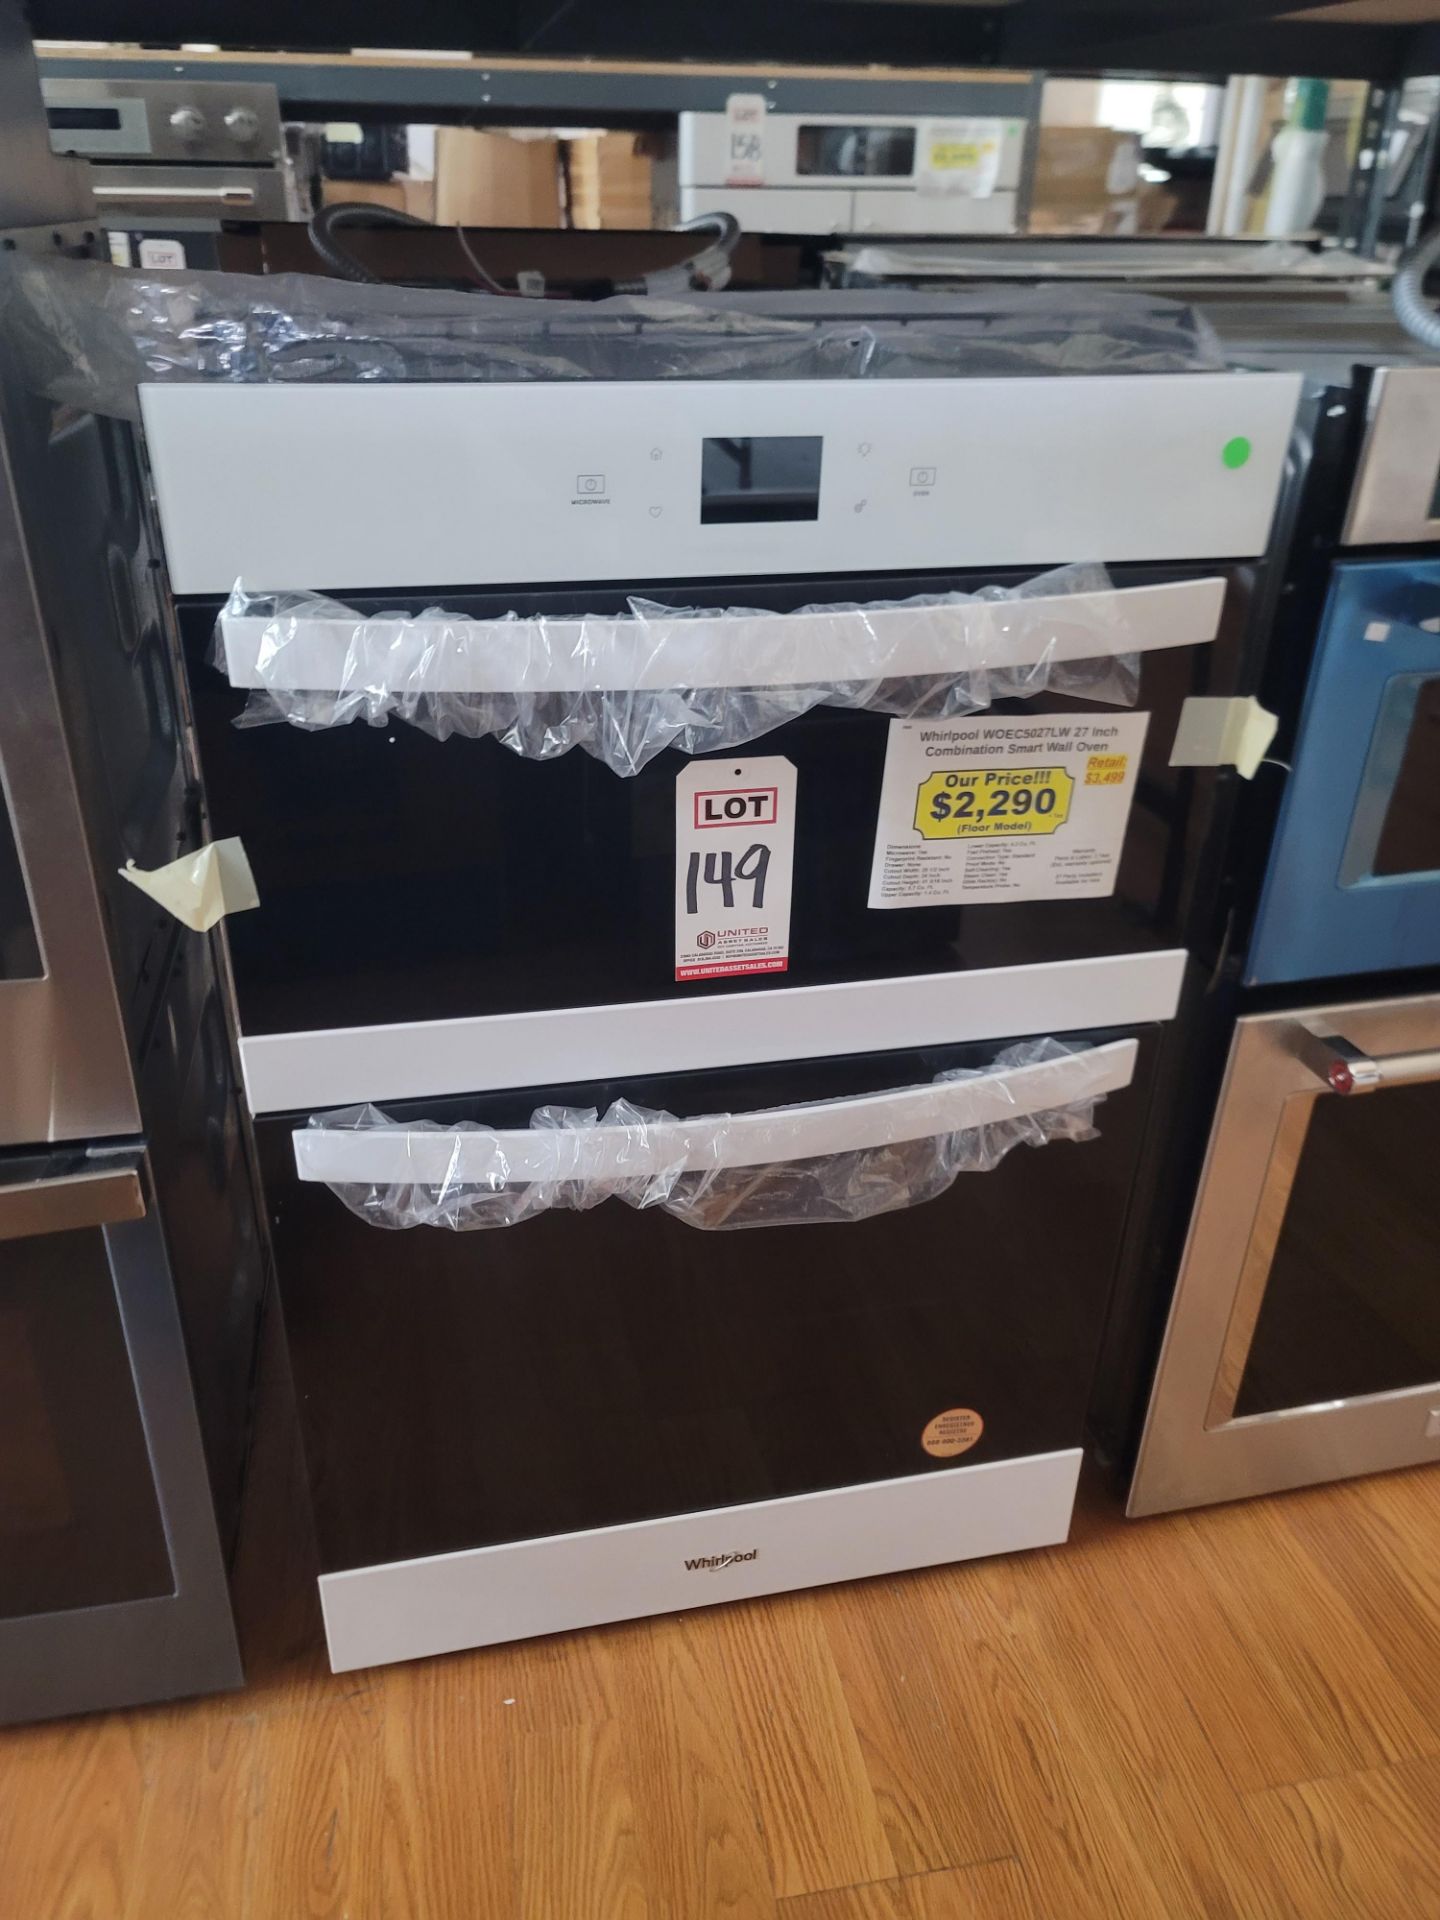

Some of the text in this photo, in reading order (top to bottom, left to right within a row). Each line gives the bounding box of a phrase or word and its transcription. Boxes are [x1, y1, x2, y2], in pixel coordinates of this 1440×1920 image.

[920, 726, 1118, 743] Whirlpool WOEC5027LW 27 Inch
[925, 742, 1108, 757] Combination Smart Wall Oven
[945, 771, 1051, 788] Our Price!!!
[705, 795, 768, 821] LOT
[930, 788, 1056, 822] $2,290
[957, 822, 1032, 835] (Floor Model)
[686, 843, 771, 914] 149
[717, 927, 768, 937] UNITED
[680, 961, 783, 976] WWW.UNITEDASSETSALES.COM
[684, 1549, 757, 1571] Whirlpool
